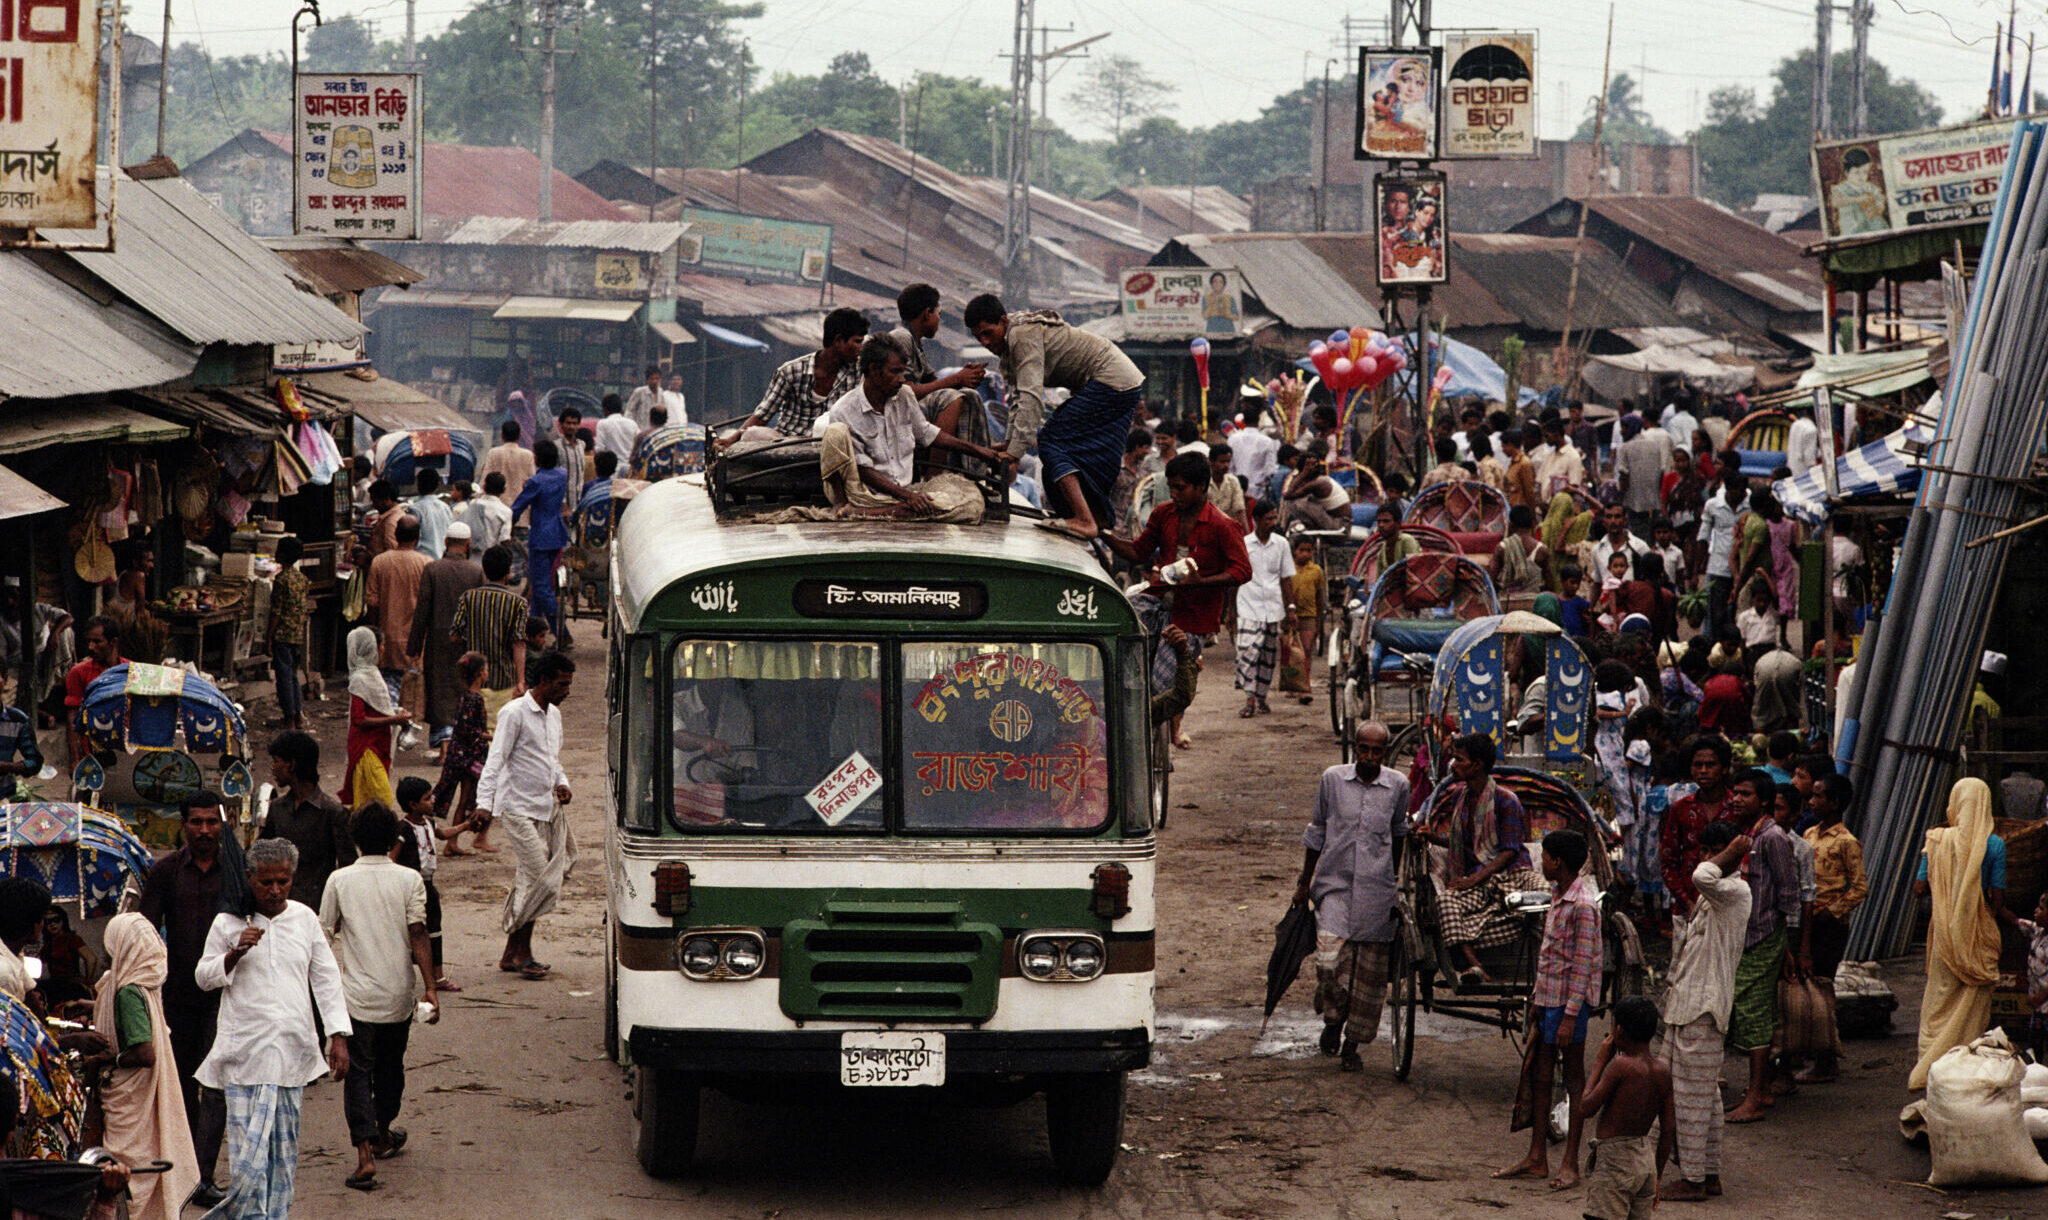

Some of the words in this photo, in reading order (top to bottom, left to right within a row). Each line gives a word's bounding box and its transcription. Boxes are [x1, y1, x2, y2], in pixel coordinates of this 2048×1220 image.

[375, 87, 408, 121] বিড়ি
[1467, 107, 1515, 127] ছাতা
[1903, 150, 1983, 180] সোহেল
[812, 758, 857, 800] রংপুর
[912, 742, 1092, 796] রাজশাহী
[817, 766, 877, 819] দিনাজপুর
